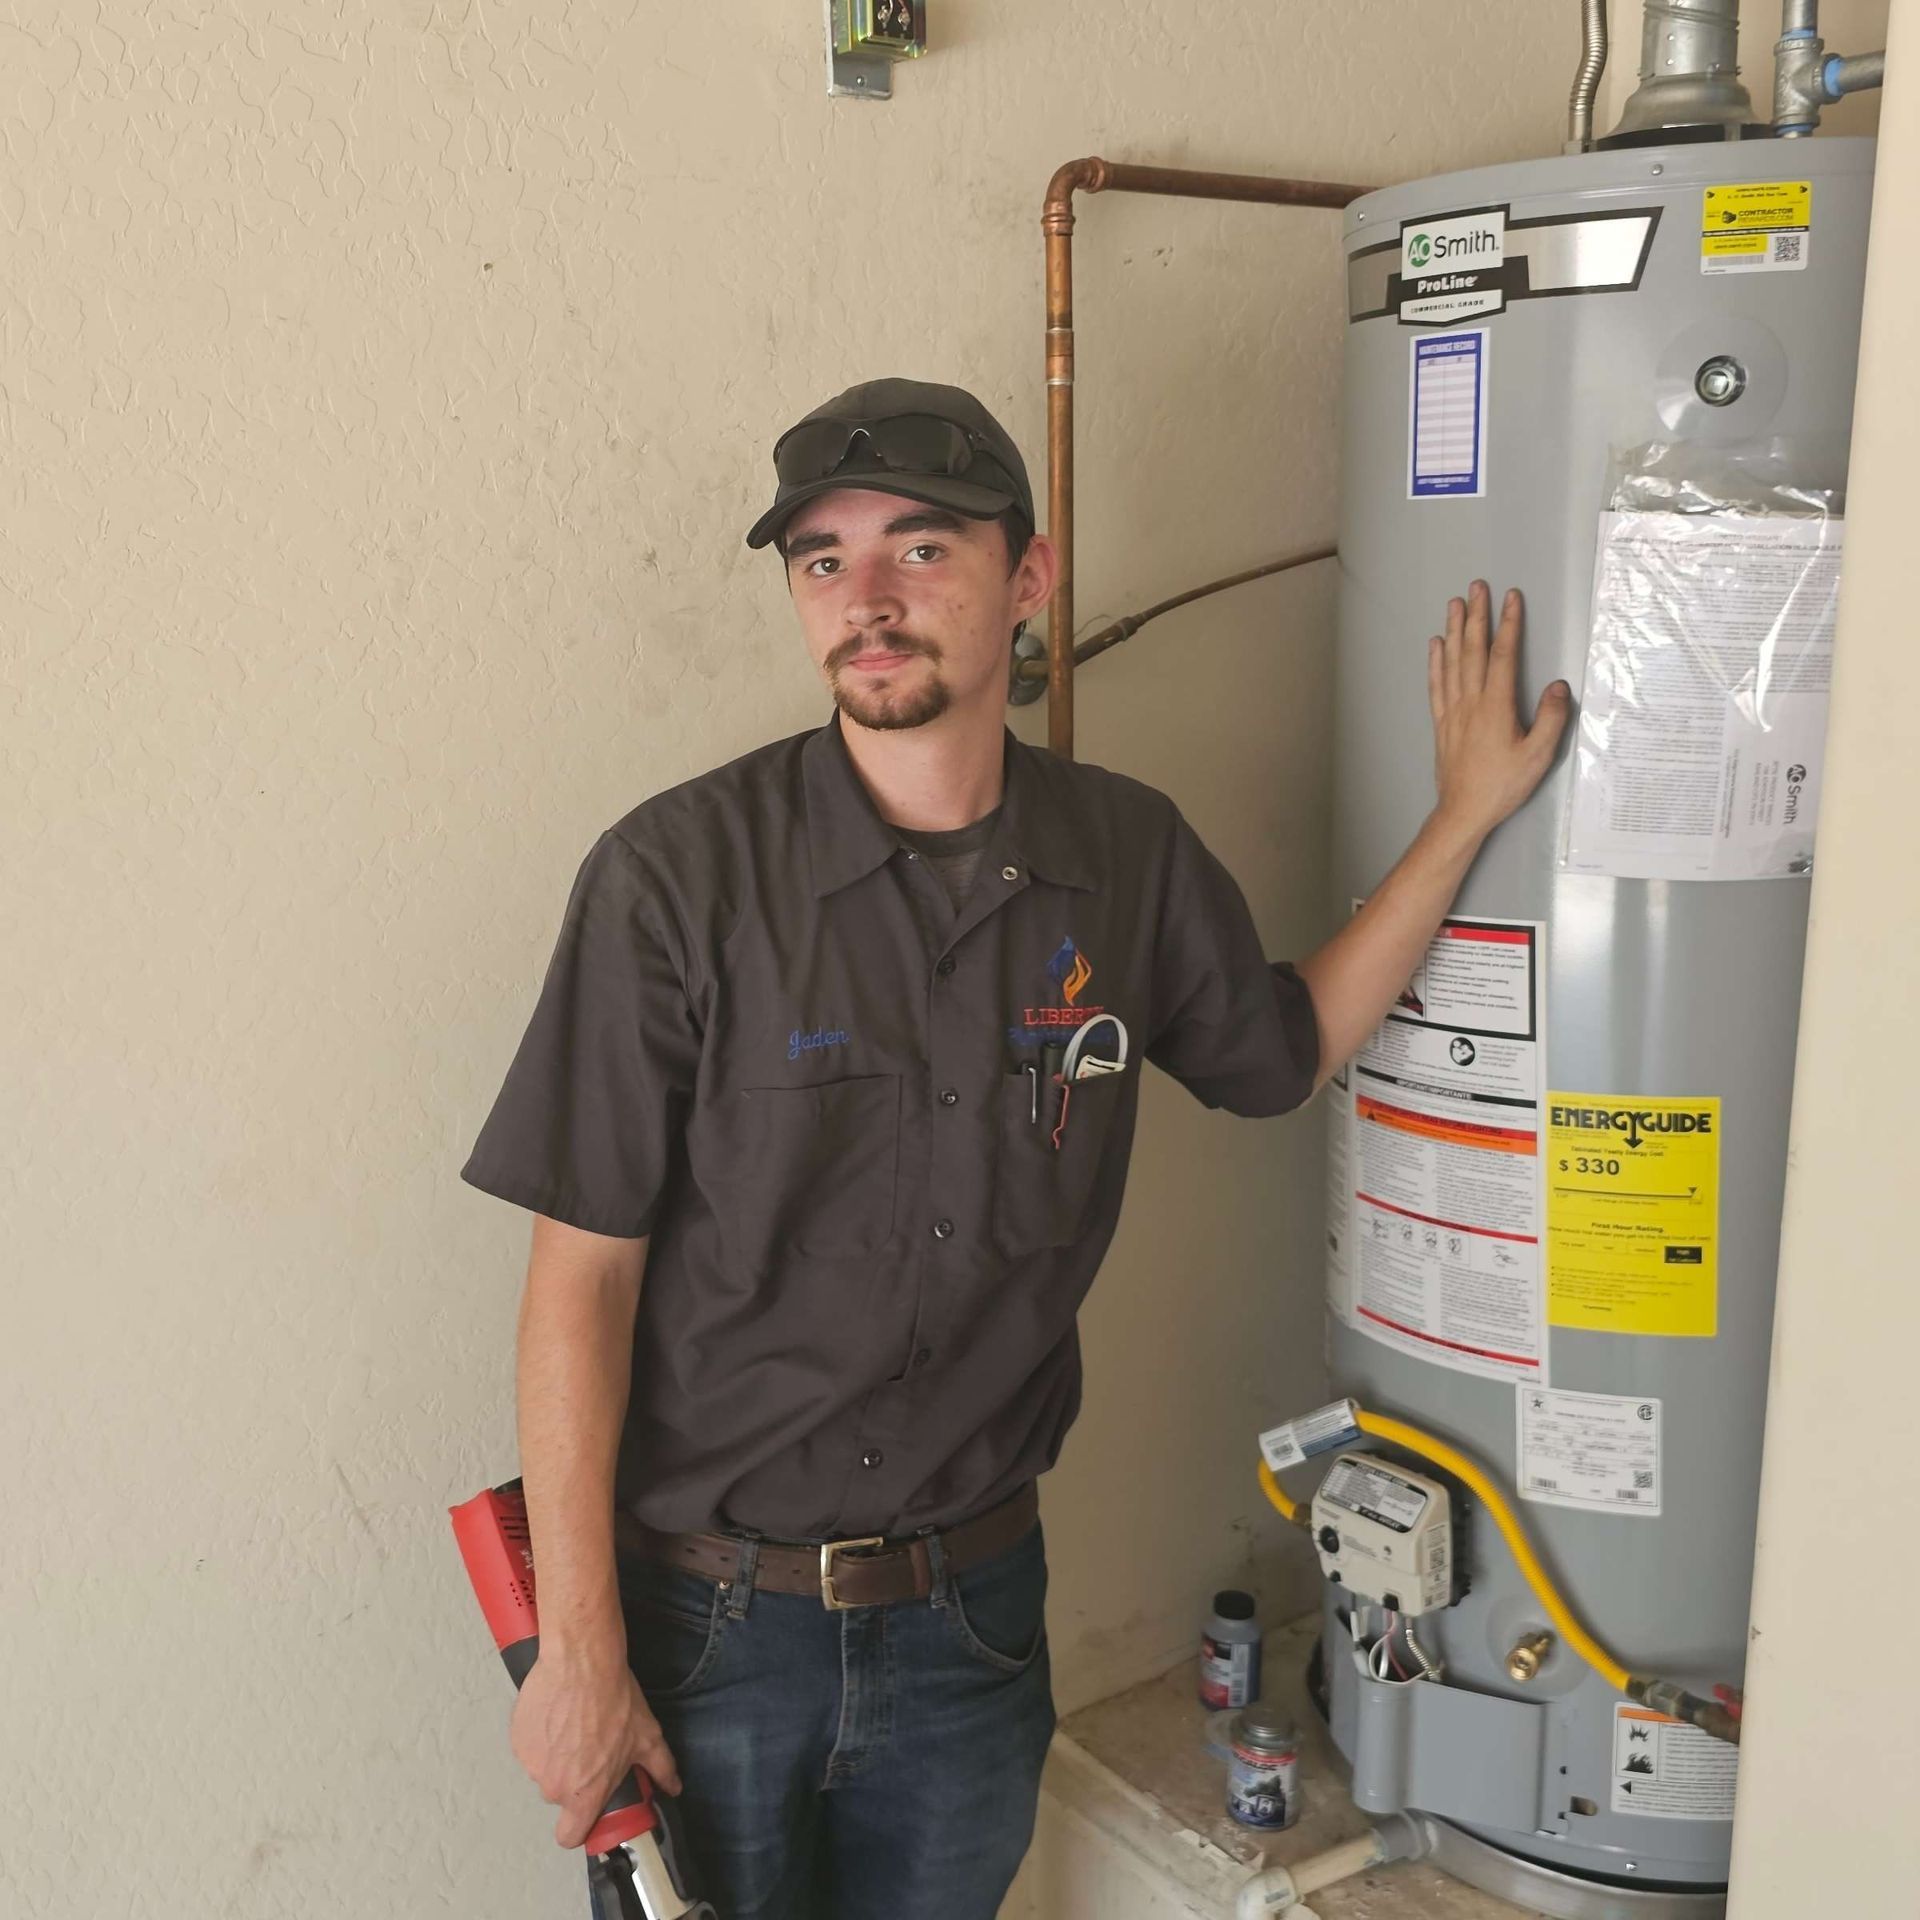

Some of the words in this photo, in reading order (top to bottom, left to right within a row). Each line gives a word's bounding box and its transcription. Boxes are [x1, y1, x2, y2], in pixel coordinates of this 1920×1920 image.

[1738, 207, 1794, 217] CONTRACTOR
[1434, 229, 1495, 258] Smith
[1417, 275, 1478, 294] ProLine
[1411, 301, 1455, 314] COMMERCIAL
[1458, 299, 1484, 308] GRADE
[1783, 784, 1802, 825] Smith
[1023, 1006, 1104, 1025] LIBER
[788, 1025, 849, 1060] Jaden
[1551, 1106, 1712, 1134] ENERGYGUIDE
[1559, 1159, 1569, 1172] $
[1576, 1157, 1620, 1176] 330
